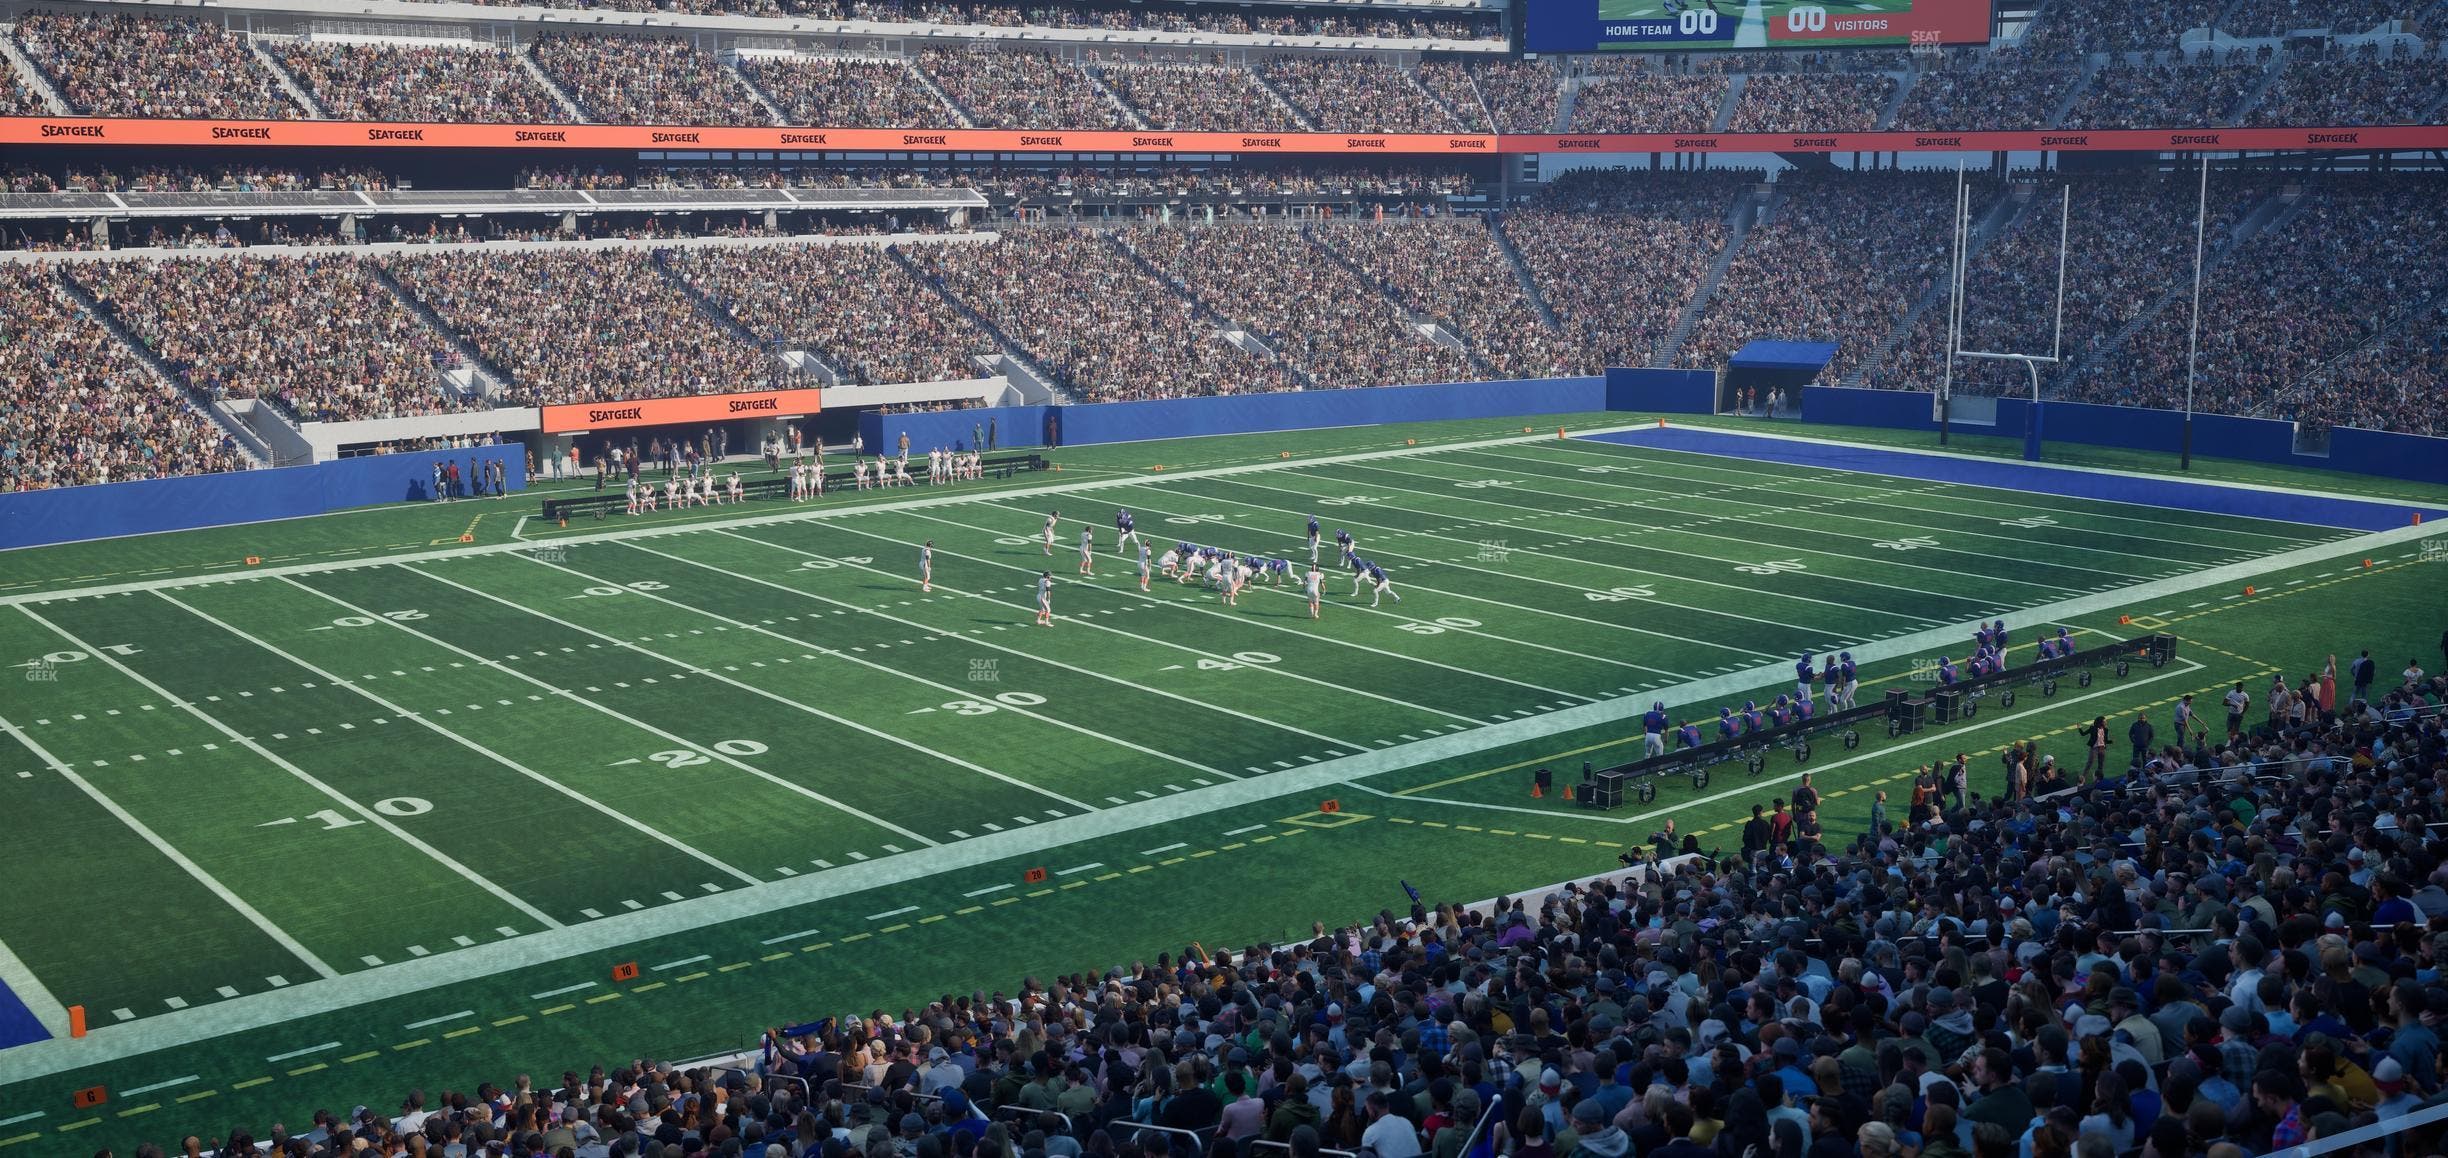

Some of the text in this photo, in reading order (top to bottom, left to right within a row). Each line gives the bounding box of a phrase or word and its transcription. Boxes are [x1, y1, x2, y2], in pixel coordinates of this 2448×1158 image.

[1606, 9, 1718, 36] HOME TEAM 00
[1788, 6, 1888, 32] 00 VISITORS
[41, 124, 105, 138] SEATGEEK
[212, 127, 271, 139] SEATGEEK
[368, 129, 423, 141] SEATGEEK
[515, 131, 566, 142] SEATGEEK
[652, 132, 700, 143] SEATGEEK
[780, 134, 826, 144] SEATGEEK
[903, 135, 946, 145] SEATGEEK
[1020, 136, 1062, 146] SEATGEEK
[1133, 137, 1173, 147] SEATGEEK
[1242, 138, 1281, 147] SEATGEEK
[1675, 138, 1717, 148] SEATGEEK
[1793, 138, 1837, 147] SEATGEEK
[1915, 137, 1961, 147] SEATGEEK
[2041, 136, 2088, 146] SEATGEEK
[2170, 134, 2220, 145] SEATGEEK
[2307, 132, 2358, 144] SEATGEEK
[1347, 139, 1385, 148] SEATGEEK
[1450, 139, 1487, 149] SEATGEEK
[1558, 139, 1601, 149] SEATGEEK
[729, 397, 778, 413] SEATGEEK
[589, 407, 642, 423] SEATGEEK
[1584, 587, 1657, 602] 40
[1393, 617, 1483, 635] 50
[1197, 651, 1282, 671] 40
[940, 691, 1048, 716] 30
[648, 739, 769, 769] 20
[304, 797, 434, 830] 10
[621, 965, 632, 977] 10
